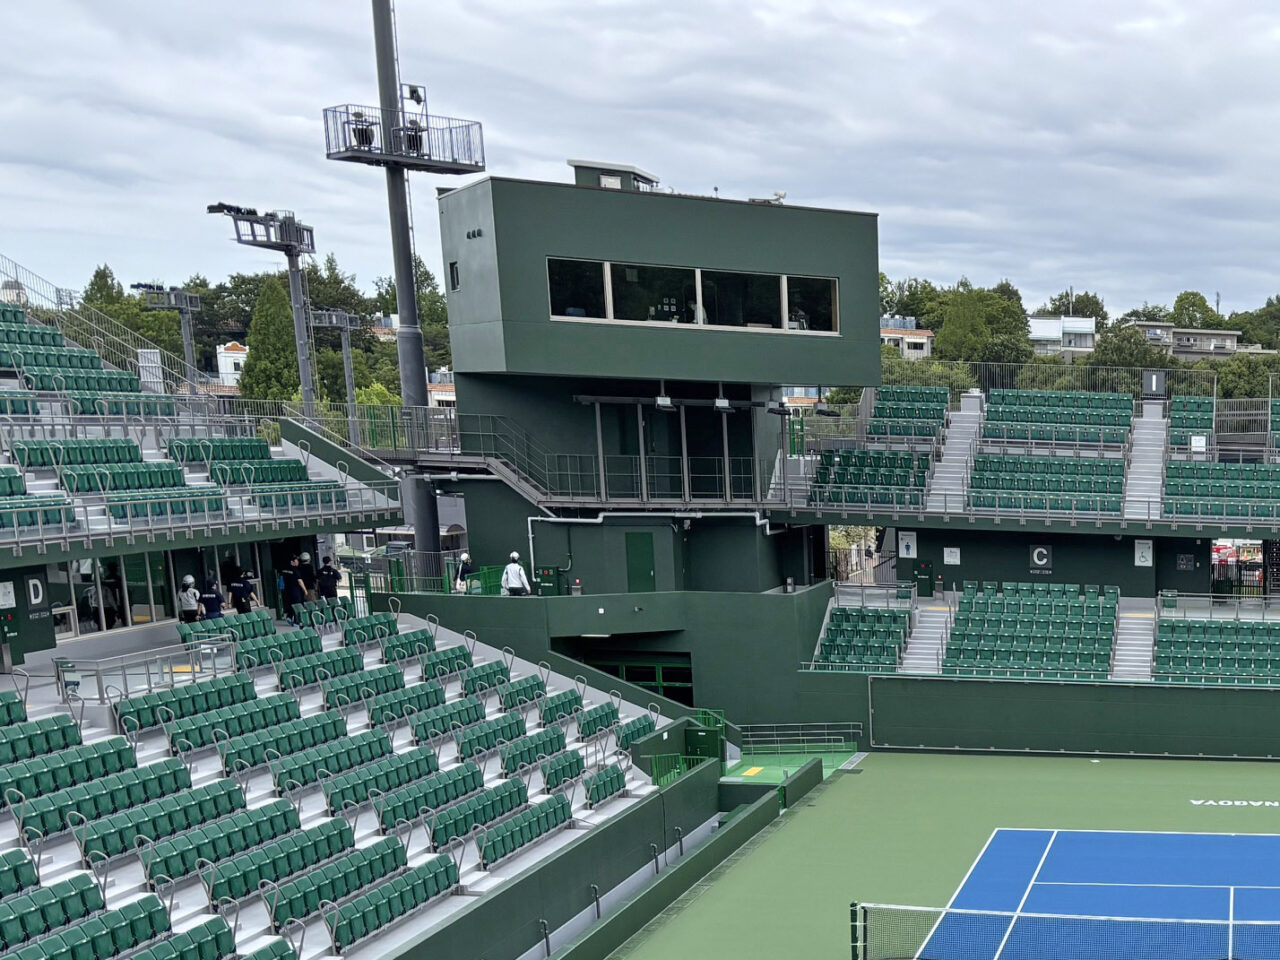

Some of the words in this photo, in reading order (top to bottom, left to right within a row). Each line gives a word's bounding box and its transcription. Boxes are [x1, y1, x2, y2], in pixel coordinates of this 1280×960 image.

[1033, 547, 1048, 565] C
[28, 578, 43, 605] D
[1189, 799, 1280, 807] NAGOYA
